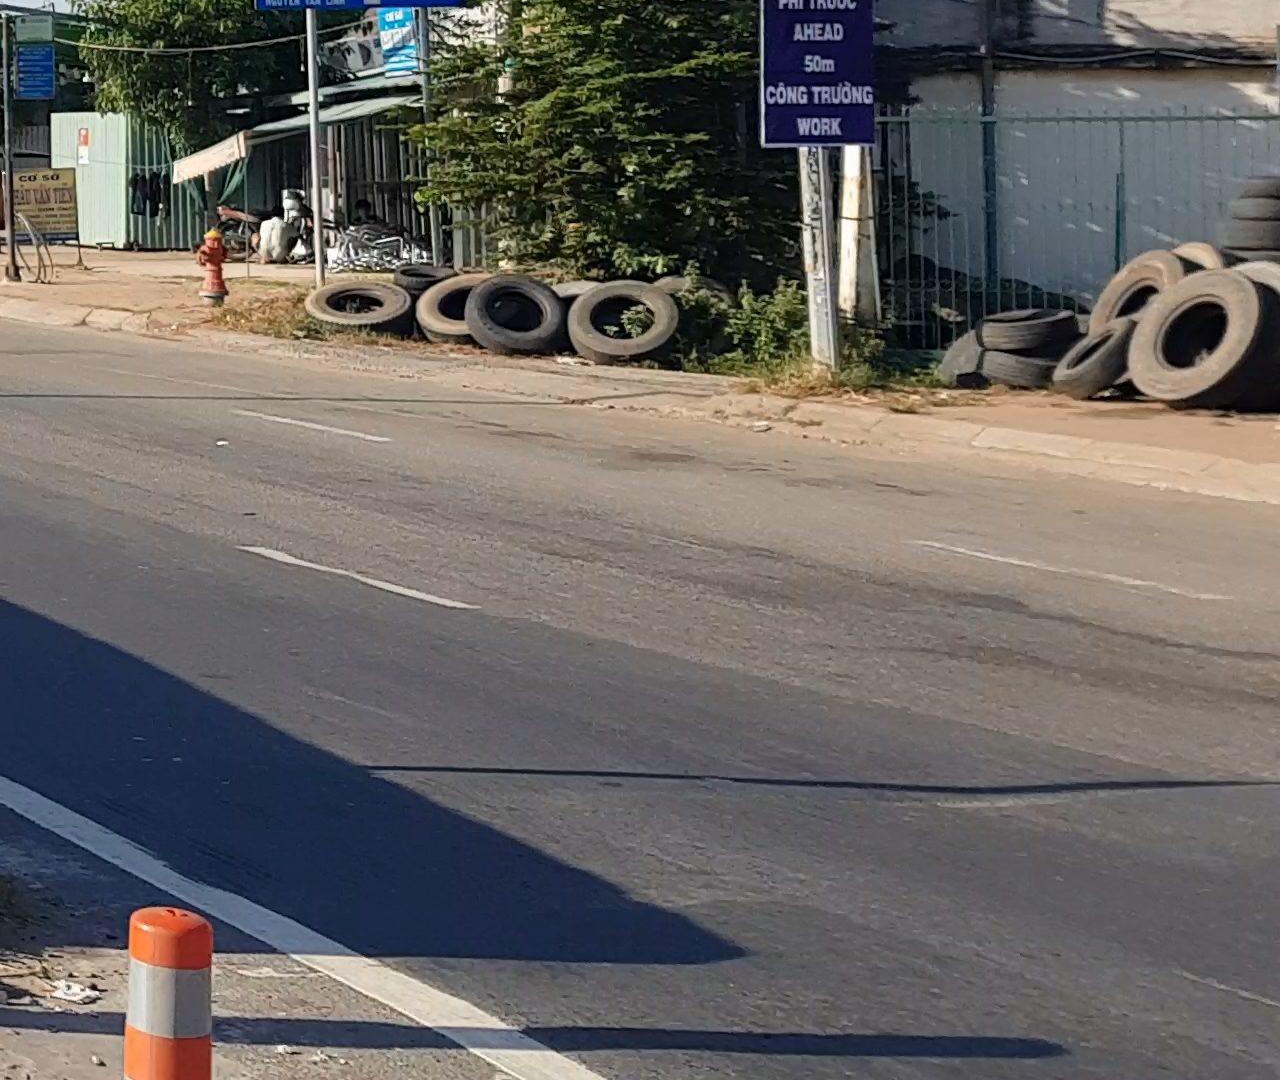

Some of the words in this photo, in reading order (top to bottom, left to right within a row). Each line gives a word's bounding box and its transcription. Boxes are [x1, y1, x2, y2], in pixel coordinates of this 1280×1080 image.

[793, 23, 844, 42] AHEAD
[803, 55, 835, 73] 50m
[766, 82, 808, 105] CÔNG
[811, 81, 874, 105] TRƯỜNG
[796, 117, 843, 136] WORK
[18, 173, 38, 183] CƠ
